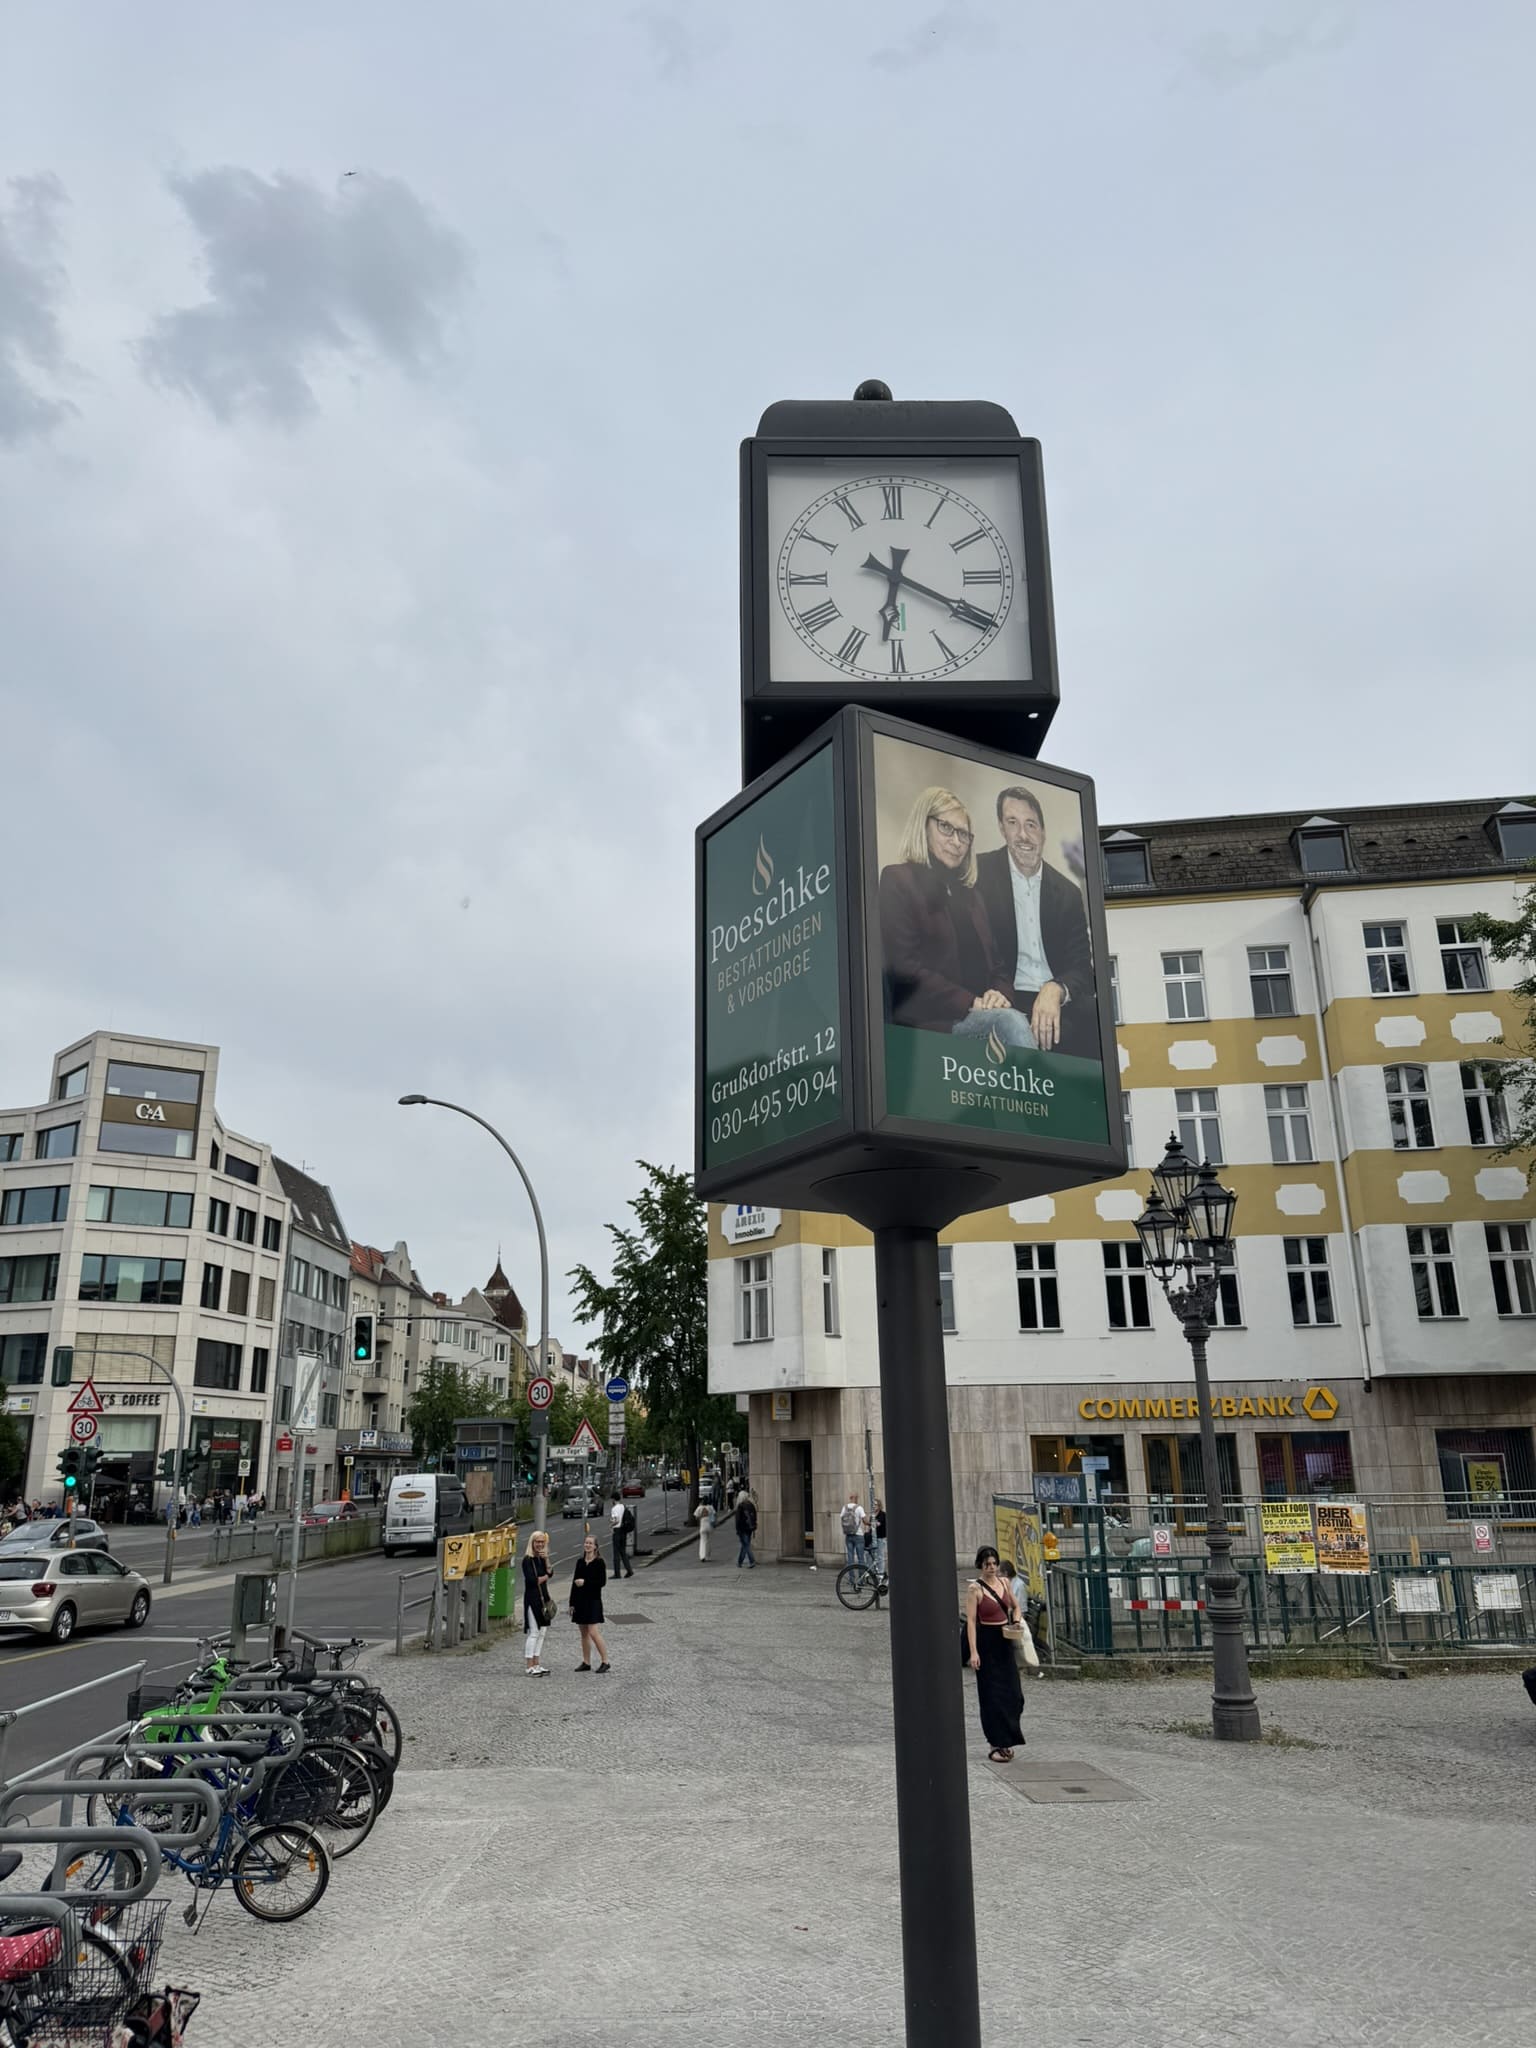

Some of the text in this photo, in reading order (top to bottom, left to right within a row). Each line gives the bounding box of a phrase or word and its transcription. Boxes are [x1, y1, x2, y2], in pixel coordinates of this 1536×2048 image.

[962, 568, 1002, 587] III
[711, 864, 831, 964] Poeschke
[718, 911, 822, 993] BESTATTUNGEN
[728, 948, 811, 1014] & VORSORGE
[712, 1026, 836, 1103] Grußdorfstr. 12
[941, 1055, 1055, 1097] Poeschke
[135, 1103, 167, 1121] C&A
[712, 1065, 837, 1143] 030-495 90 94
[951, 1090, 1049, 1117] BESTATTUNGEN
[734, 1227, 766, 1239] Immobilien
[122, 1394, 161, 1406] COFFEE
[533, 1385, 548, 1401] 30
[76, 1421, 93, 1434] 30
[1261, 1503, 1309, 1513] STREET FOOD
[1317, 1507, 1350, 1519] BIER
[1317, 1518, 1353, 1528] FESTIVAL
